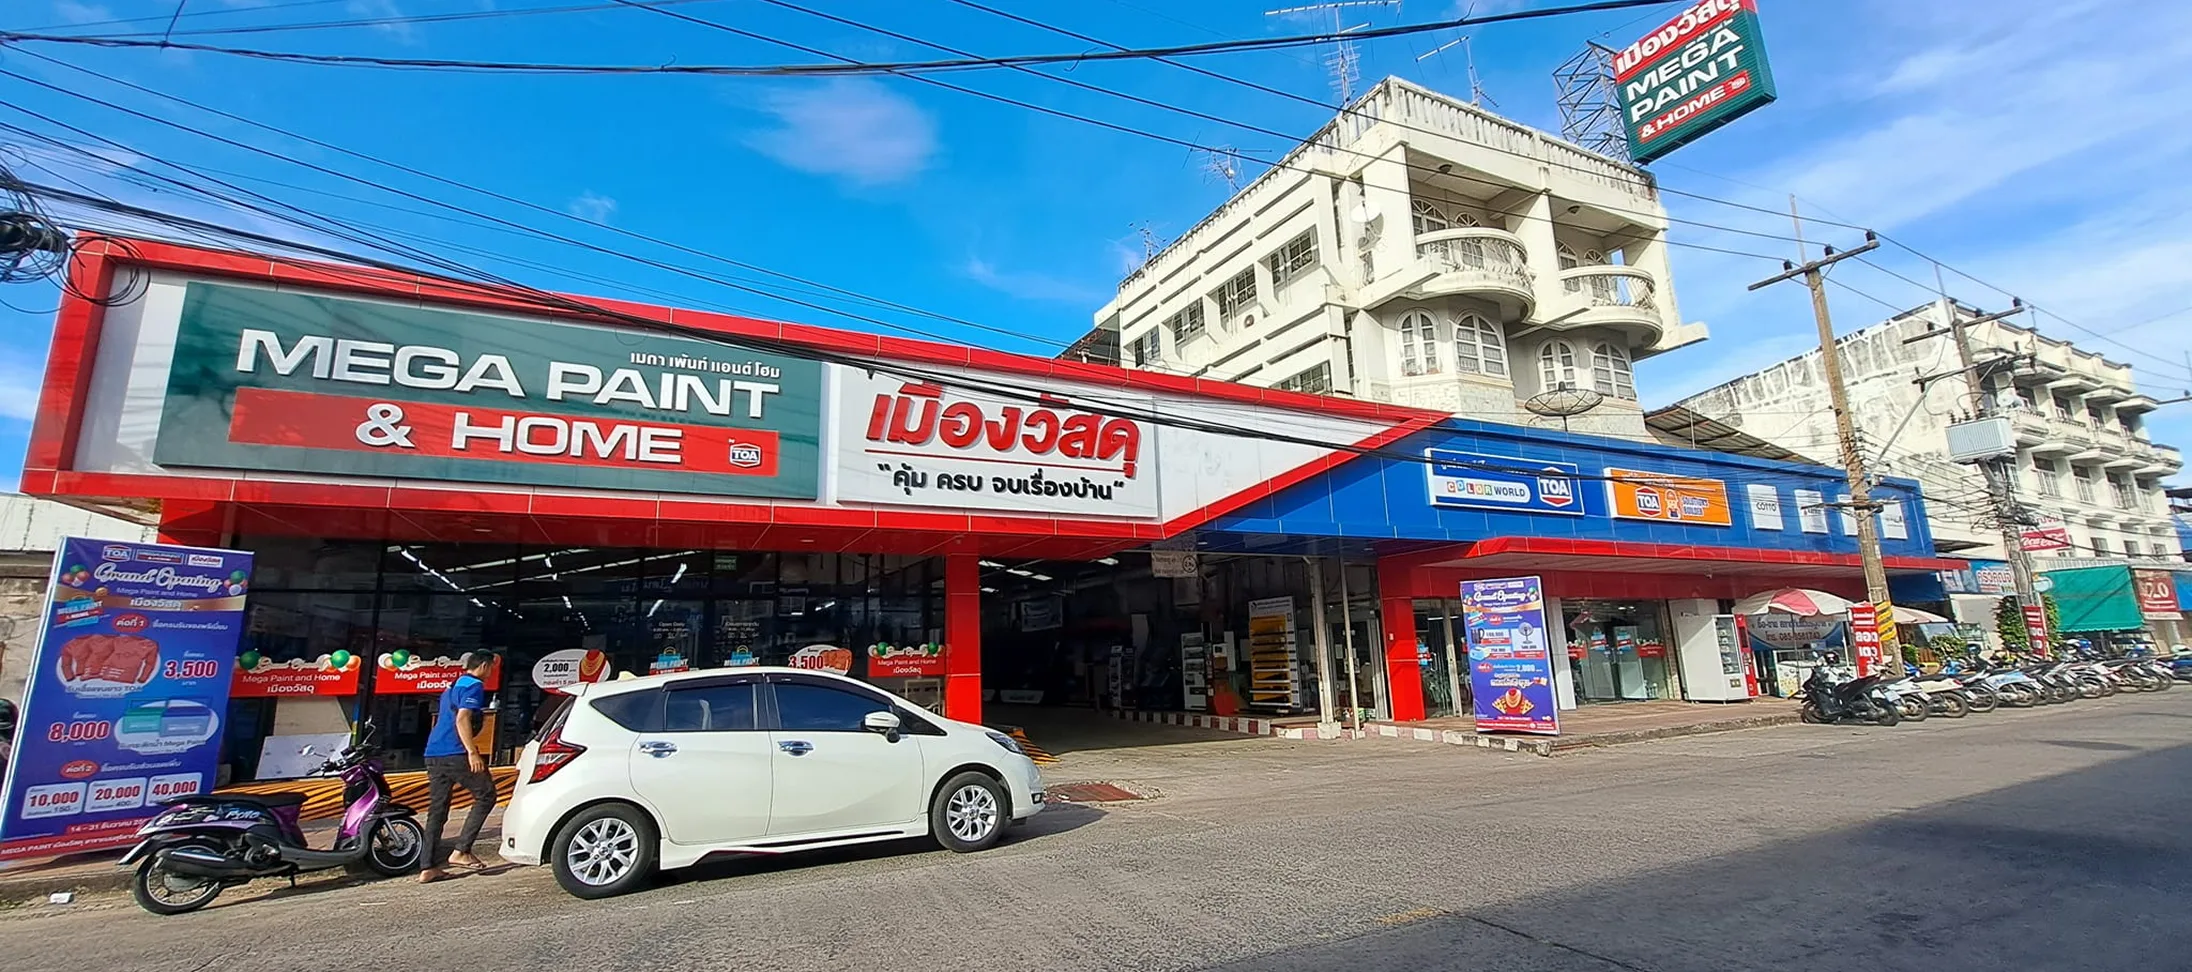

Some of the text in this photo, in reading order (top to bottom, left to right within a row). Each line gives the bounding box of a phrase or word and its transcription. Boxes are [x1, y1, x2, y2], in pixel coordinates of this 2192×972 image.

[1626, 29, 1740, 101] MEGA
[1631, 45, 1743, 123] PAINT
[1641, 85, 1725, 138] & HOME
[236, 328, 780, 418] MEGA PAINT
[631, 352, 665, 366] เมกา
[711, 361, 751, 375] แอนด์
[755, 362, 780, 378] โฮม
[355, 402, 682, 464] & HOME
[865, 379, 1140, 478] เมืองวัสดุ
[732, 450, 758, 460] TOA
[937, 471, 983, 492] ครบ
[1447, 480, 1526, 497] COLOR WORLD
[1540, 479, 1570, 496] TOA
[1638, 496, 1660, 509] TOA
[1756, 502, 1777, 512] COTTO
[105, 549, 129, 557] TOA
[94, 562, 222, 593] Grand Opening
[164, 660, 218, 679] 3,500
[394, 672, 418, 680] Mega
[420, 671, 440, 679] Paint
[544, 662, 569, 673] 2,000
[243, 673, 341, 684] Mega Paint and Home
[267, 683, 315, 694] เมืองวัสดุ
[48, 721, 110, 743] 8,000
[95, 786, 141, 801] 20,000
[152, 781, 197, 796] 40,000
[29, 792, 79, 807] 10,000
